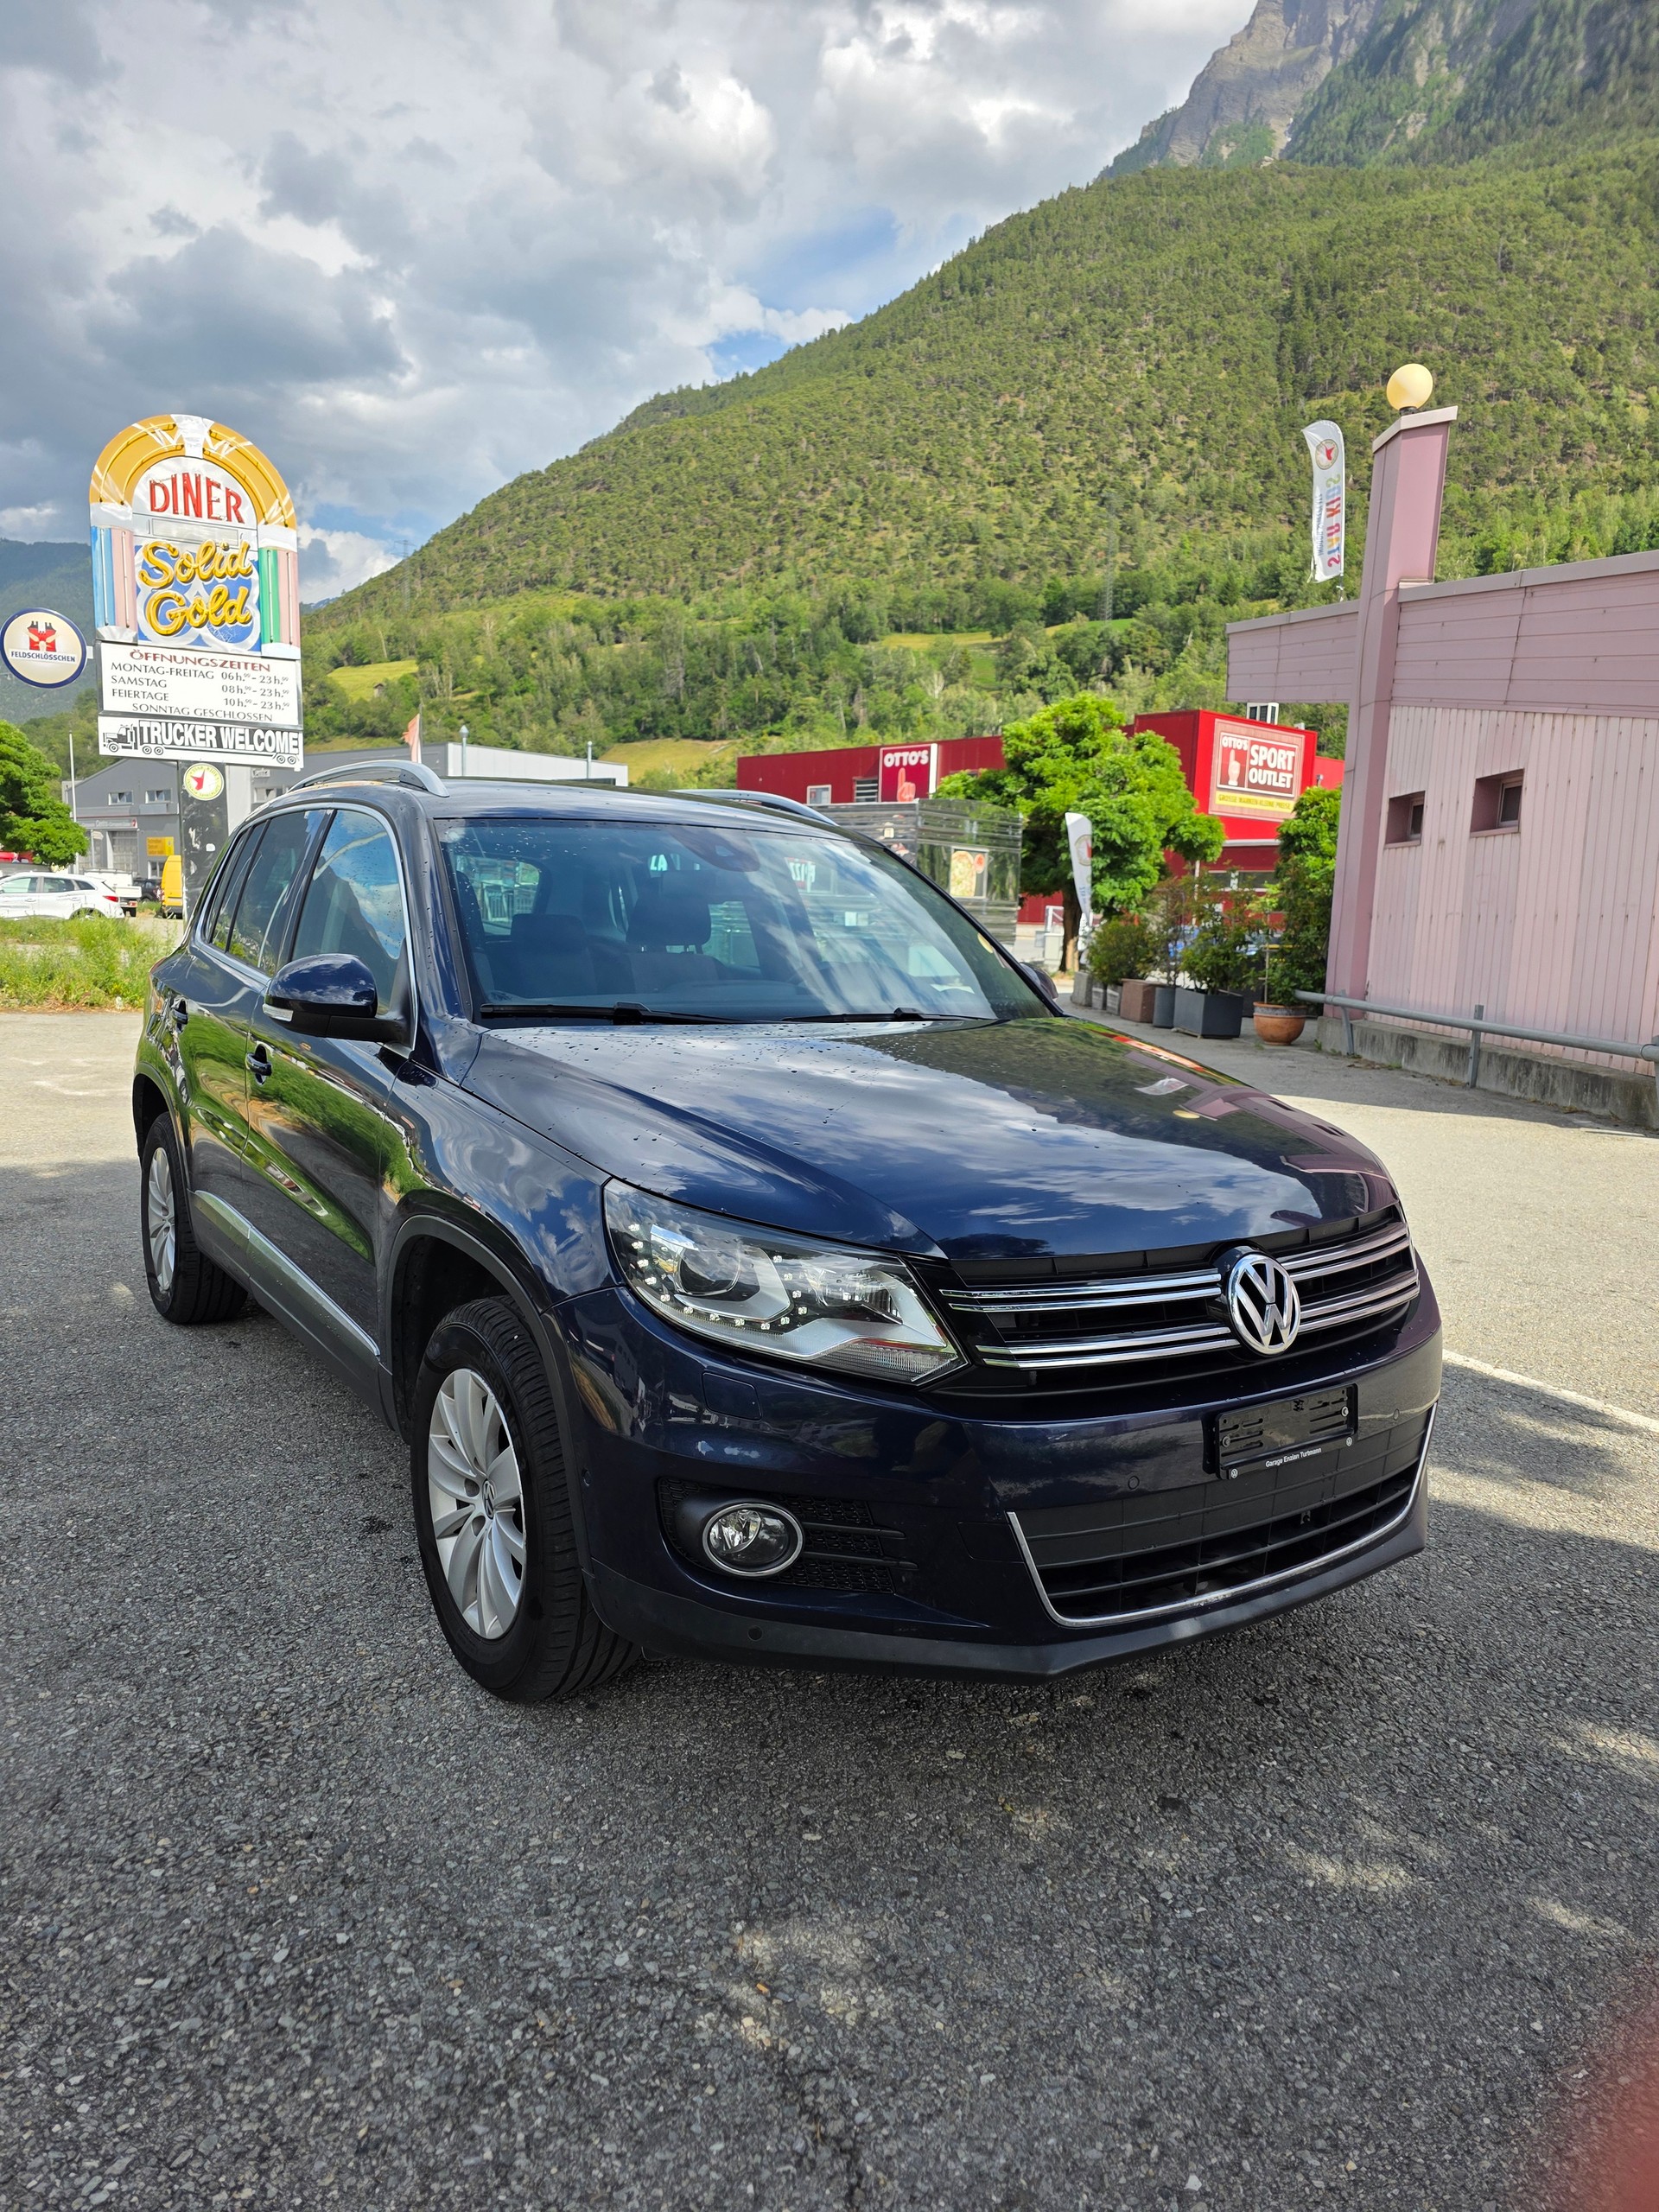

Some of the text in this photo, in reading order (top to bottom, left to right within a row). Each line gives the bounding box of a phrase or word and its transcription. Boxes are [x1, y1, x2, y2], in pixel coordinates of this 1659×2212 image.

[149, 473, 245, 524] DINER
[138, 539, 254, 589] Solid
[144, 584, 253, 637] Gold
[10, 651, 76, 663] FELDSCHLÖSSCHEN
[129, 649, 271, 673] ÖFFNUNGSZEITEN
[111, 662, 215, 681] MONTAG-FREITAG
[111, 675, 168, 689] SAMSTAG
[111, 688, 169, 702] FEIERTAGE
[131, 702, 273, 722] SONNTAG GESCHLOSSEN
[139, 721, 300, 754] TRUCKER WELCOME
[1221, 735, 1249, 751] OTTO'S
[883, 749, 929, 768] OTTO'S
[1249, 744, 1296, 772] SPORT
[1249, 767, 1294, 788] OUTLET
[1229, 1254, 1300, 1354] VW
[1265, 1458, 1283, 1467] Garage
